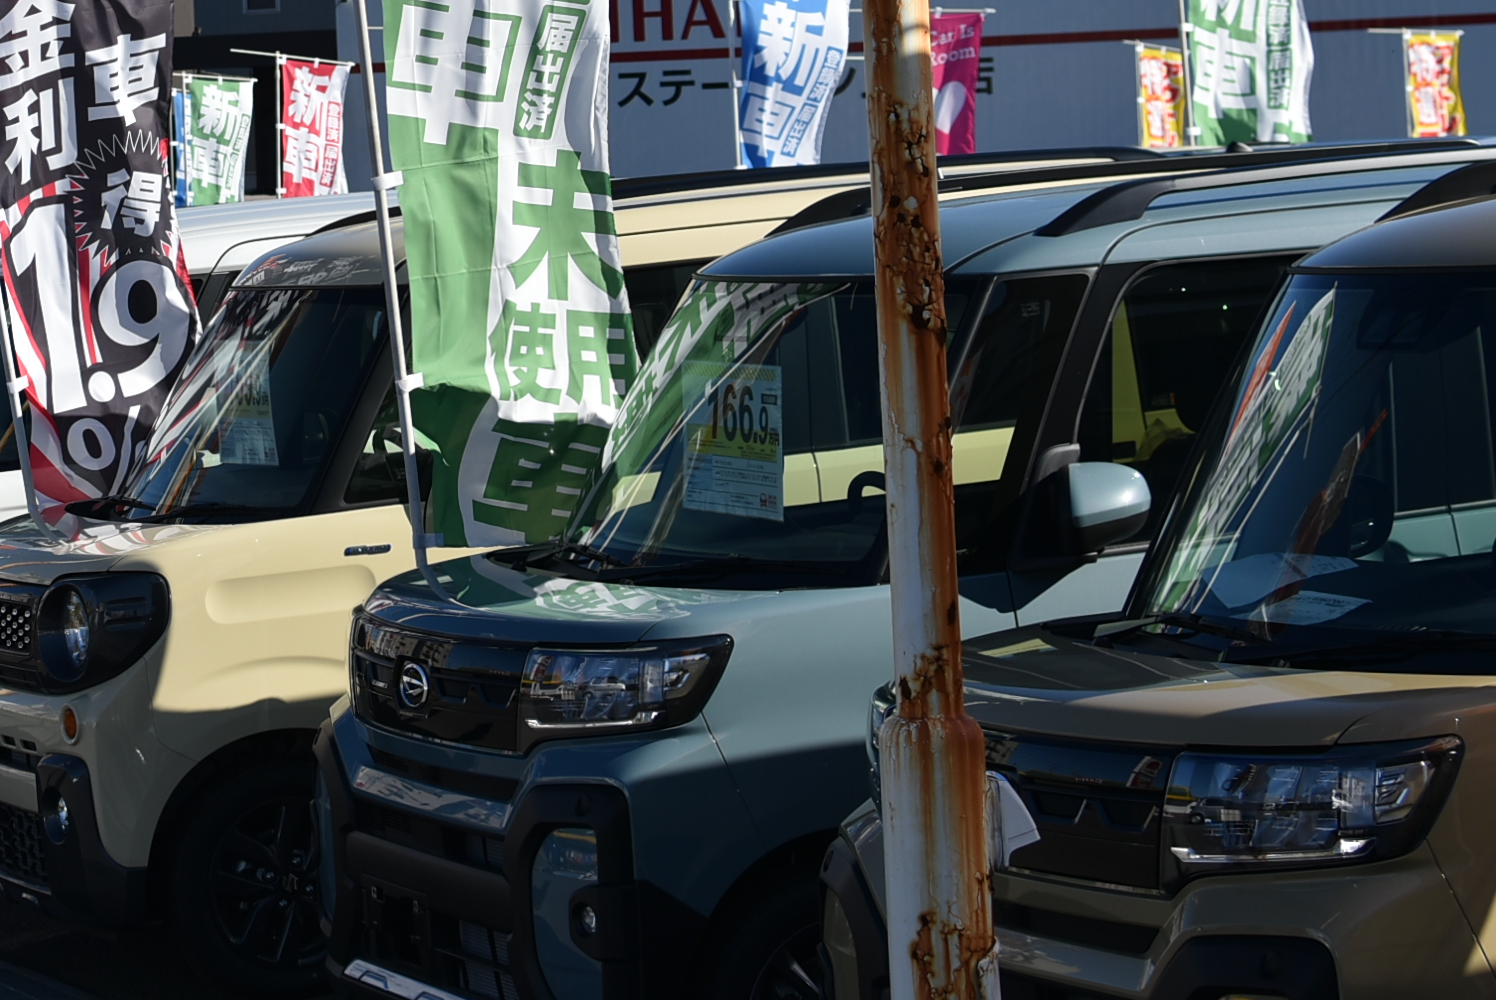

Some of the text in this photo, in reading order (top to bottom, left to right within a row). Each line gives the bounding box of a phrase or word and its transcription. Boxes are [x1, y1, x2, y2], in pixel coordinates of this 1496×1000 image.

[284, 66, 333, 184] 新車
[518, 13, 580, 134] 届出済
[740, 1, 825, 159] 新車
[191, 84, 239, 188] 新車
[101, 168, 164, 237] 得
[10, 203, 190, 414] 1.9
